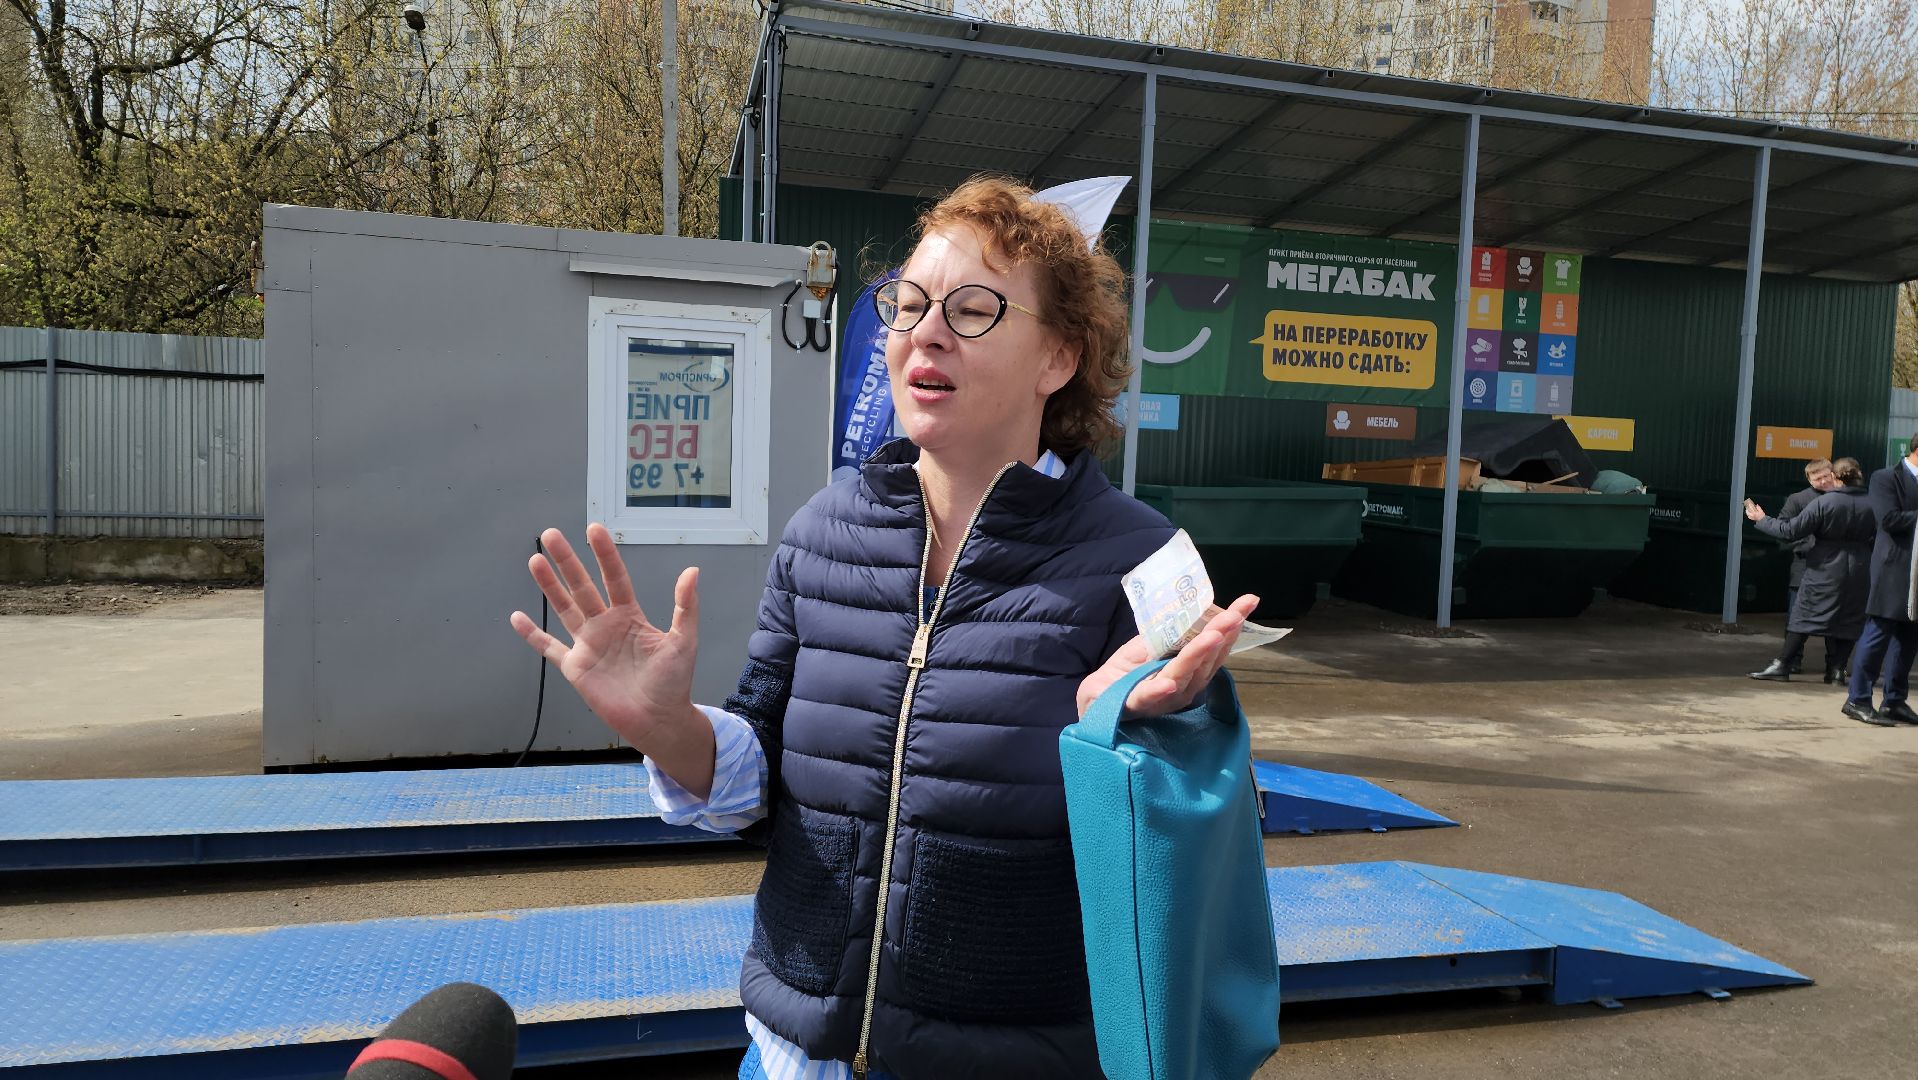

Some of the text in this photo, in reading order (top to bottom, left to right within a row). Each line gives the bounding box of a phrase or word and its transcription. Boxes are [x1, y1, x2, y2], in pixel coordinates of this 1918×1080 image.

[1269, 248, 1288, 257] ПУНКТ
[1290, 249, 1314, 259] ПРИЁМА
[1315, 253, 1353, 263] ВТОРИЧНОГО
[1267, 261, 1436, 301] МЕГАБАК
[1273, 323, 1428, 350] НА ПЕРЕРАБОТКУ
[1272, 348, 1411, 374] МОЖНО СДАТЬ:
[1367, 416, 1399, 428] МЕБЕЛЬ
[1588, 427, 1618, 440] КАРТОН
